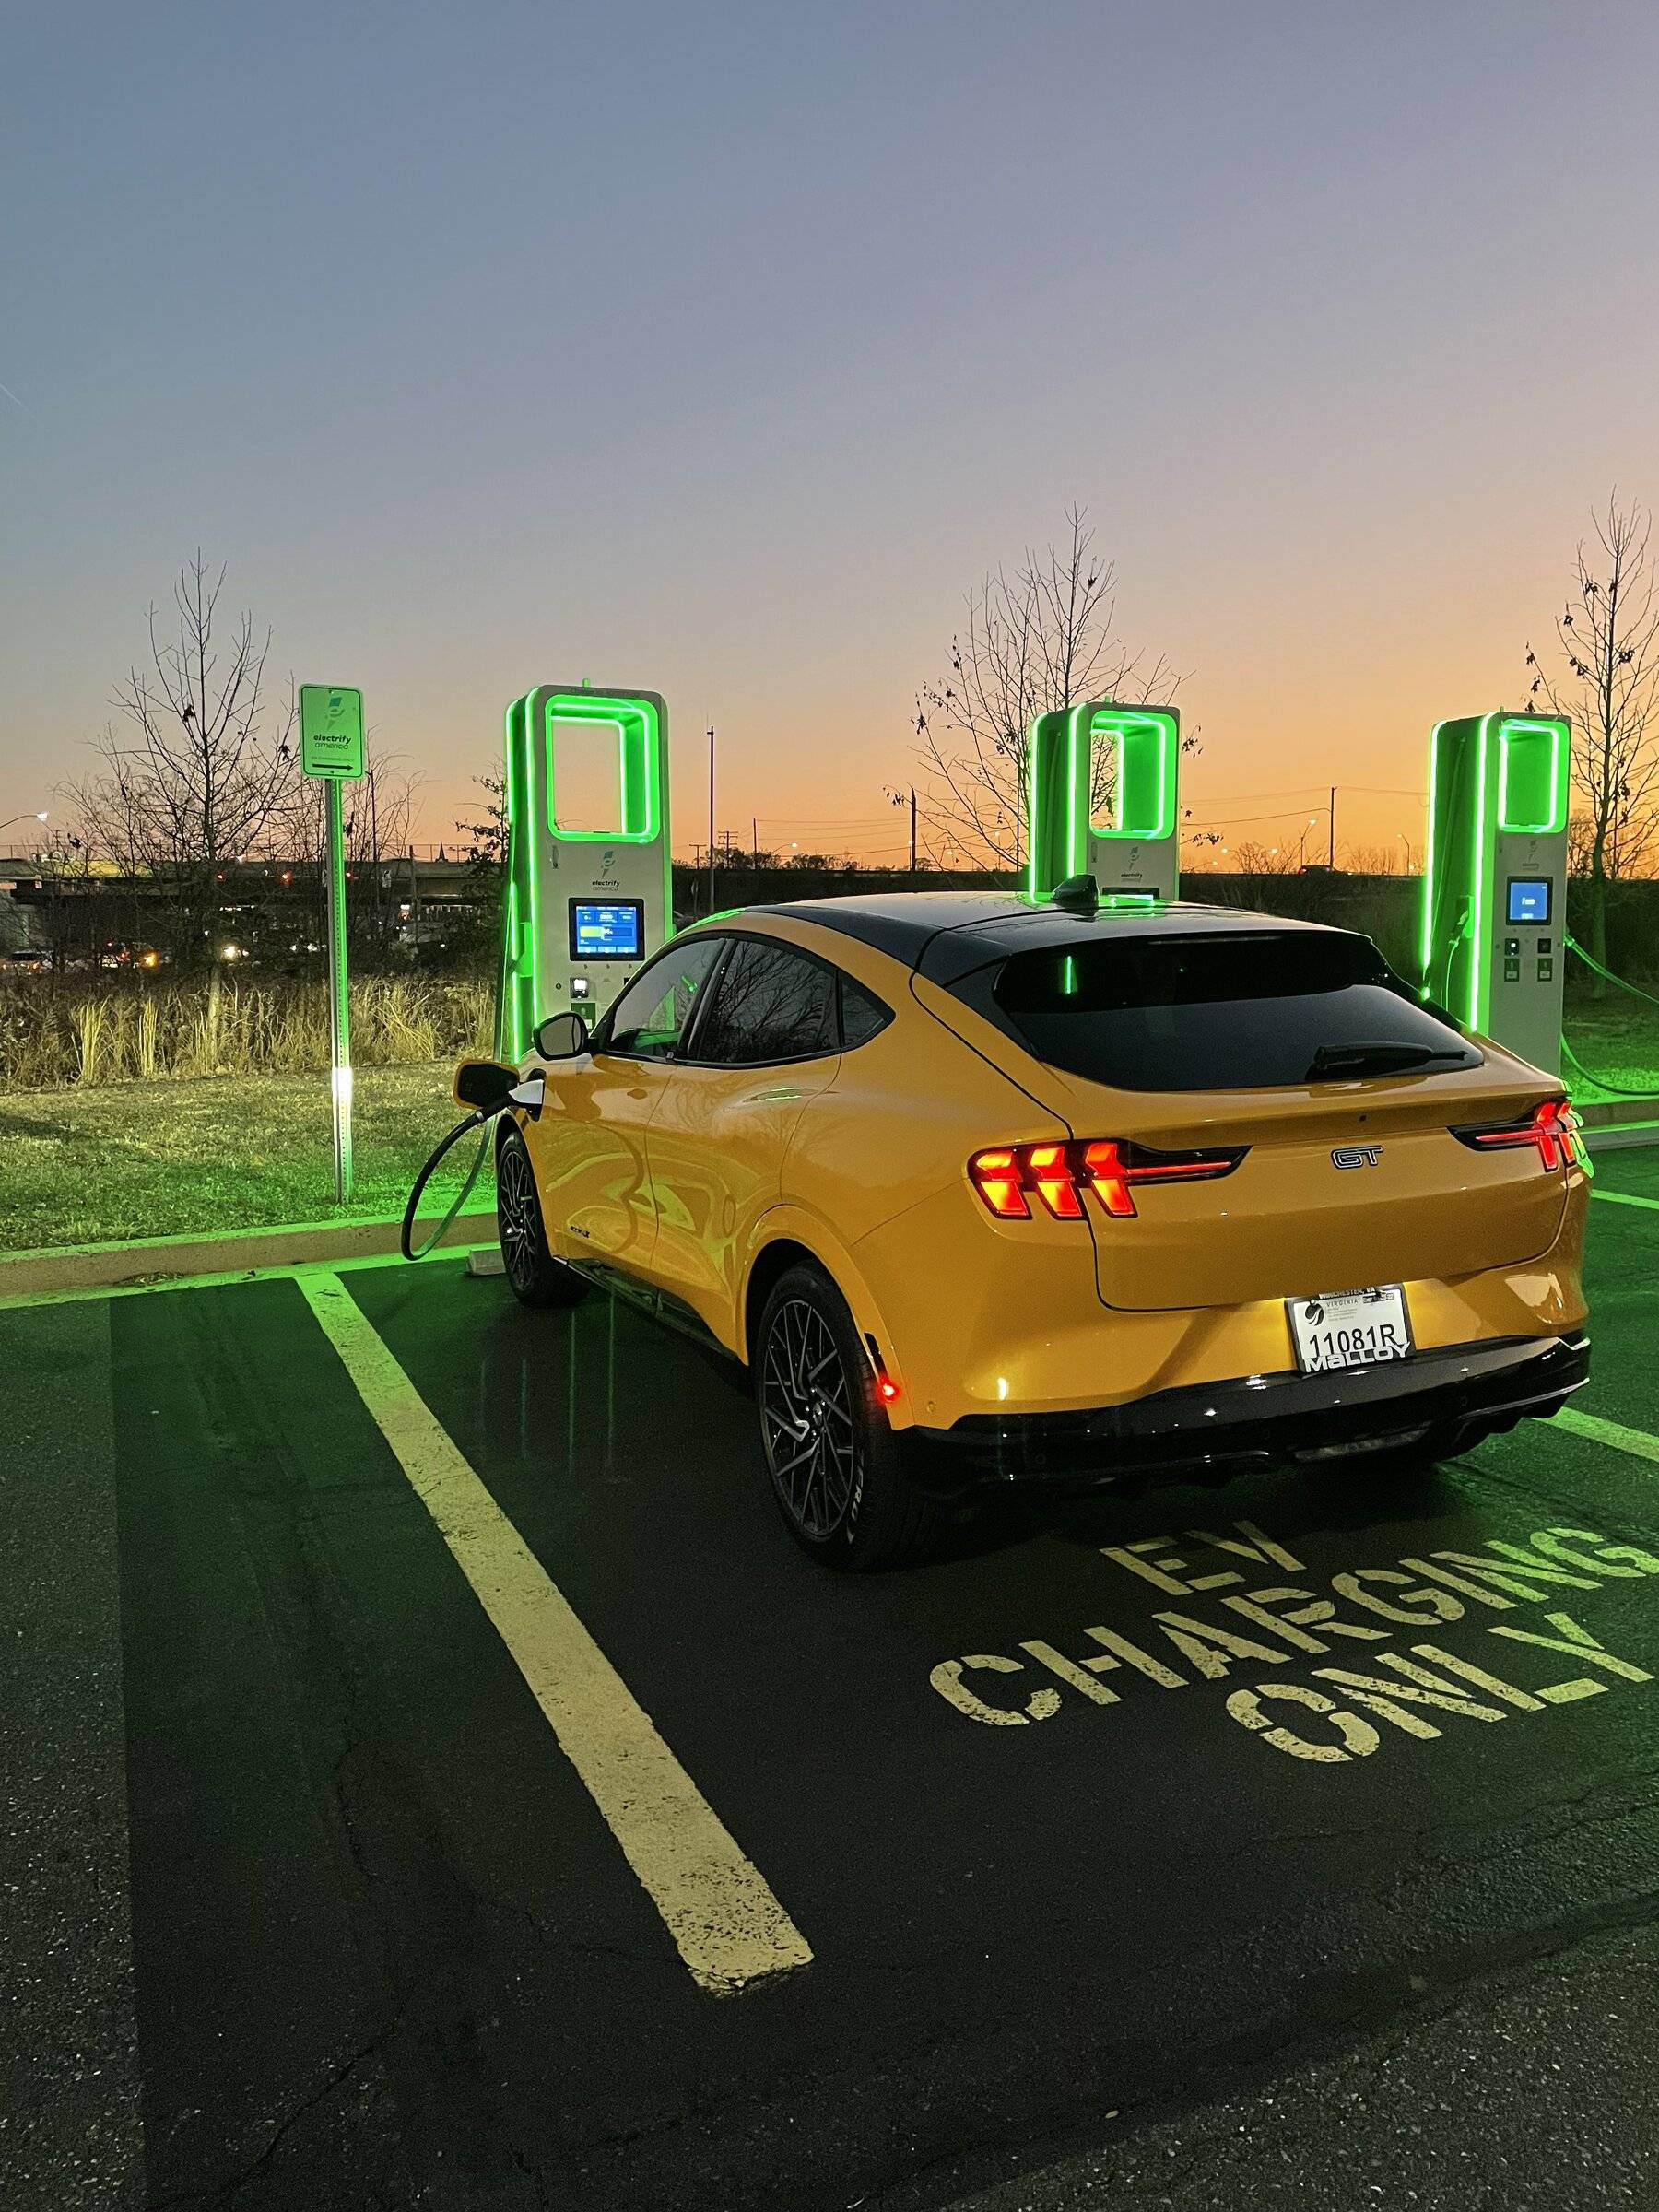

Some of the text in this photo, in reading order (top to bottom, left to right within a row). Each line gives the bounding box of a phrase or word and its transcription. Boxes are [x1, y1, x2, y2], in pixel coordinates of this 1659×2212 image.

[313, 734, 351, 744] electrify
[1332, 1146, 1383, 1169] GT
[1327, 1299, 1359, 1307] VIRGINIA
[1309, 1324, 1395, 1359] 11081R
[1098, 1521, 1307, 1596] EV
[929, 1527, 1659, 1726] CHARGING
[1226, 1612, 1657, 1763] ONLY
